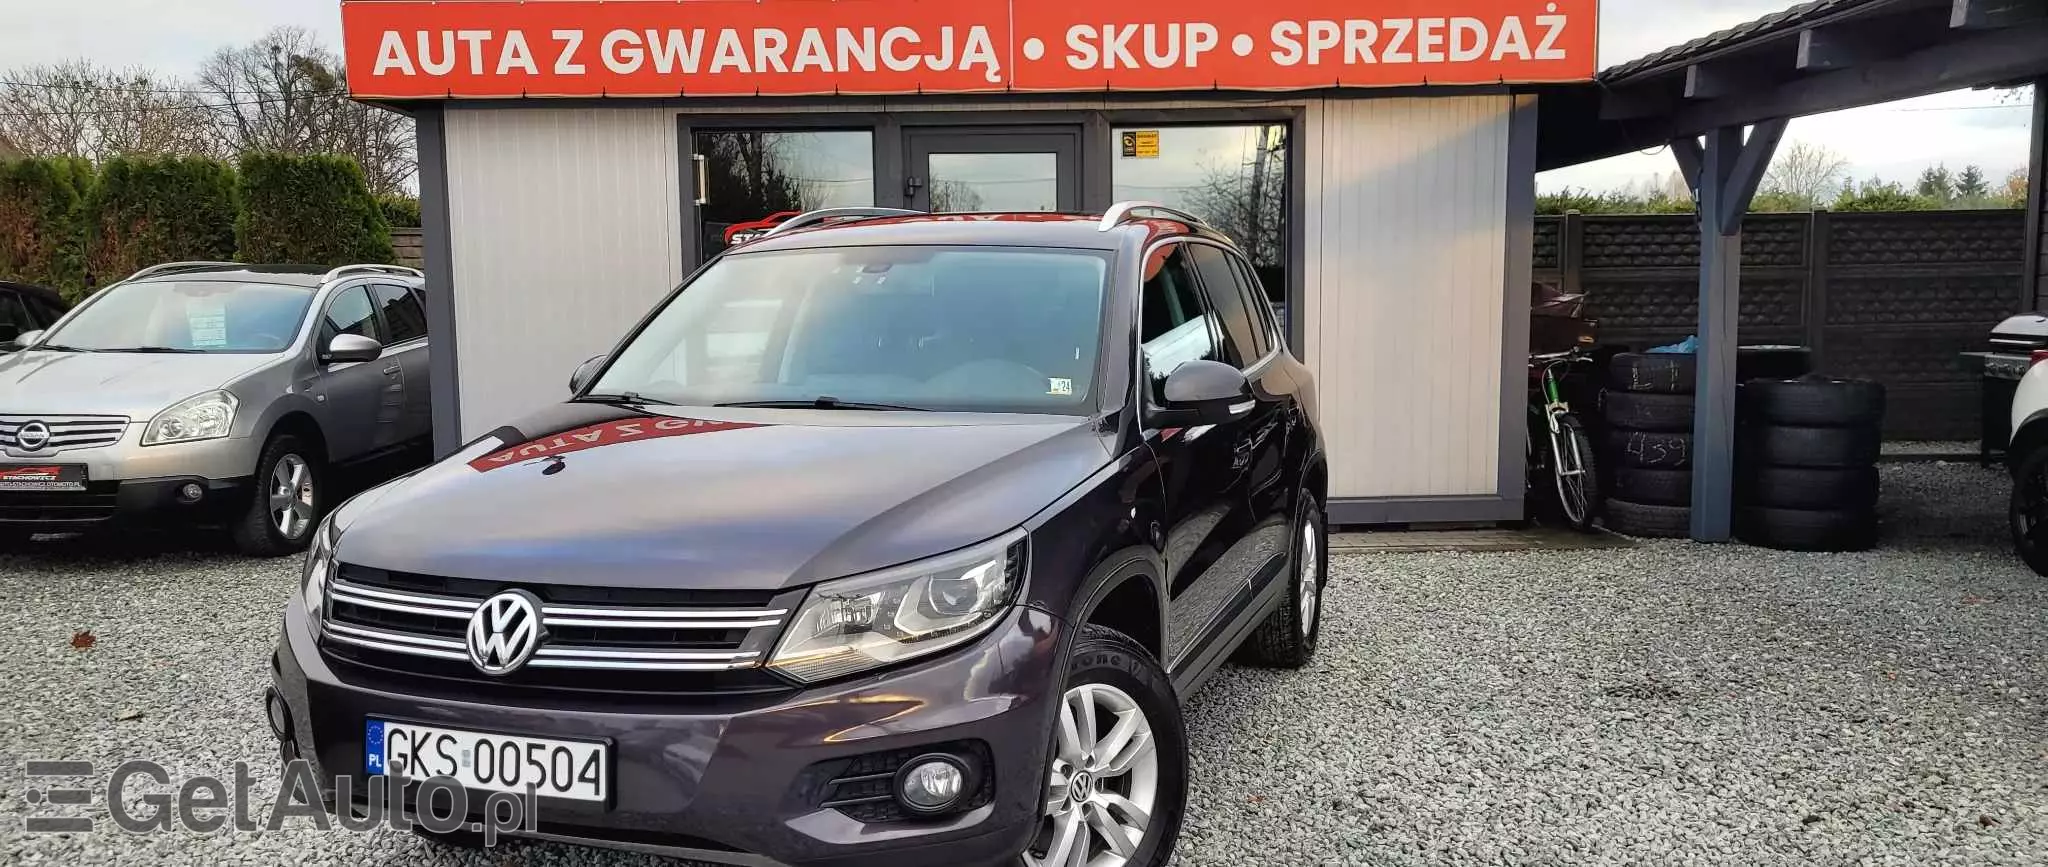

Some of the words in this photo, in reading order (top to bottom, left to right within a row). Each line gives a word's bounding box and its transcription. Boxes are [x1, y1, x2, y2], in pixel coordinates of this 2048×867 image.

[373, 30, 539, 76] AUTA
[552, 29, 586, 75] Z
[600, 25, 1002, 83] GWARANCJĄ
[1065, 23, 1219, 71] SKUP
[1270, 2, 1567, 67] SPRZEDAŻ
[368, 753, 383, 768] PL
[387, 727, 459, 779] GKS
[473, 738, 602, 797] 00504
